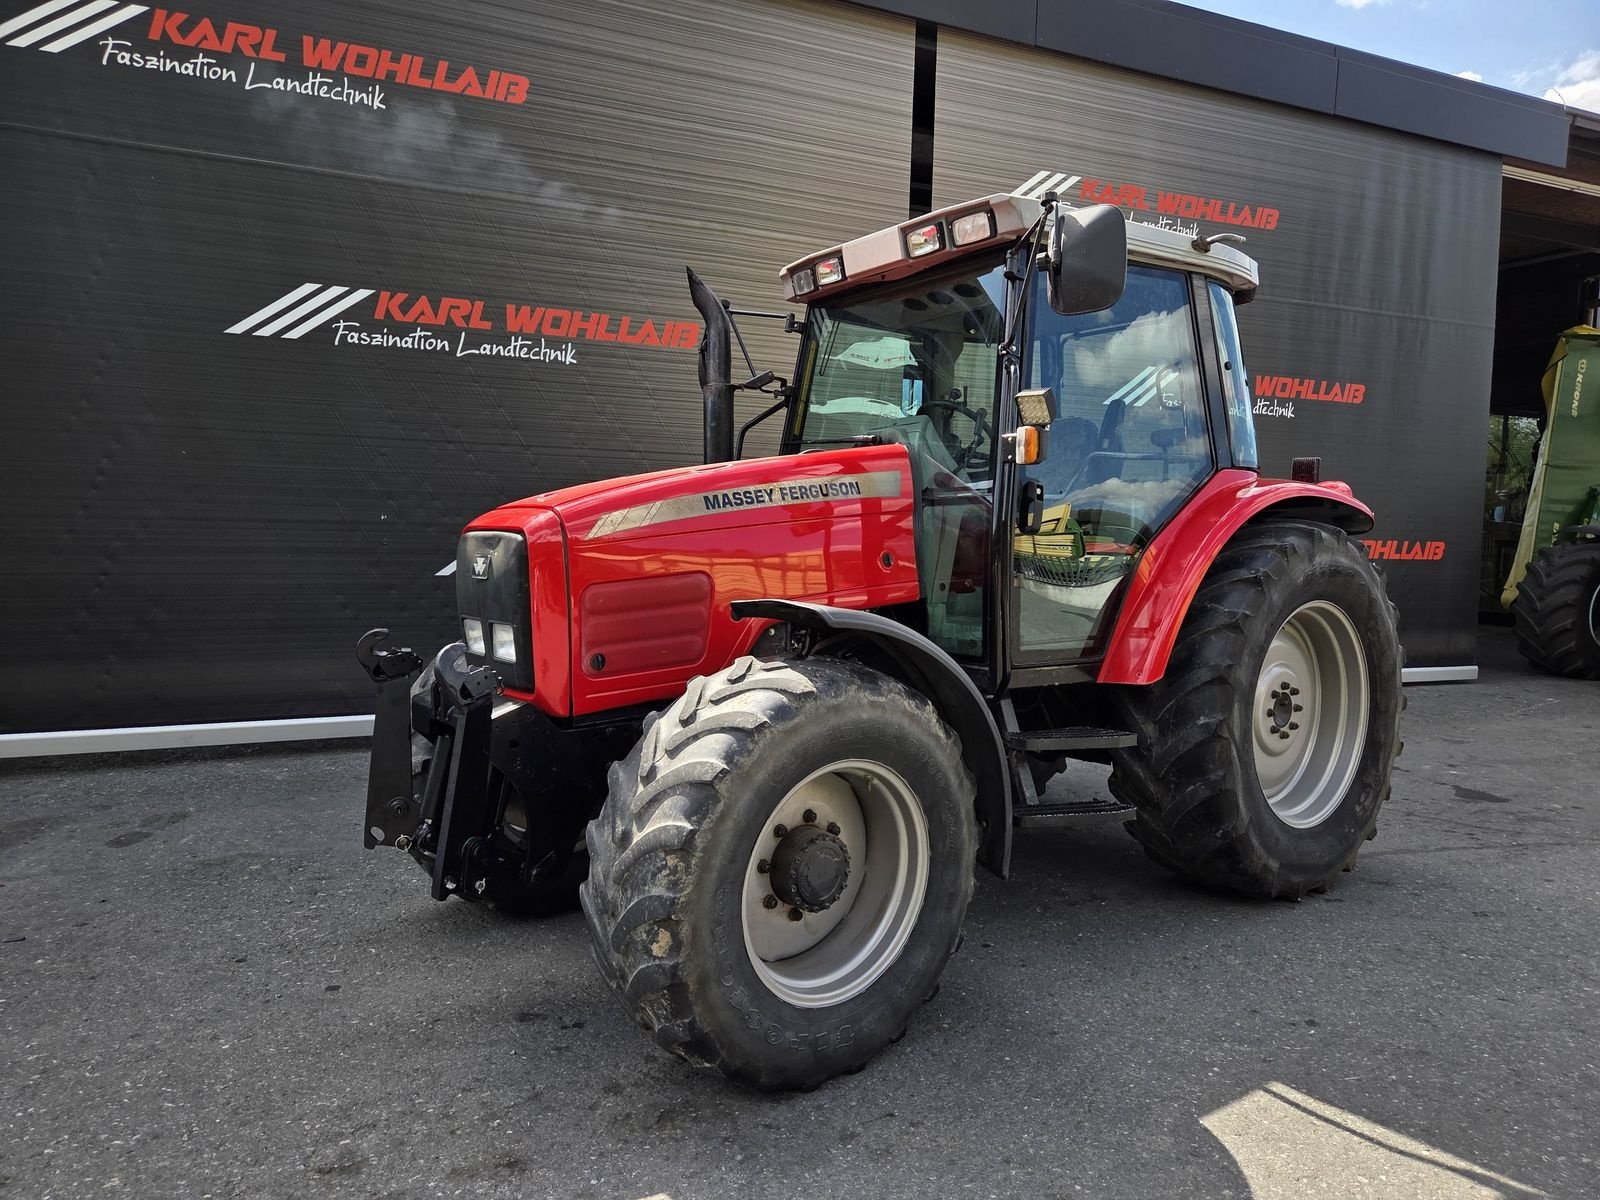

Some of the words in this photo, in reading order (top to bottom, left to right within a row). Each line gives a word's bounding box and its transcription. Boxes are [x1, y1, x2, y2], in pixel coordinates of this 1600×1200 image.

[148, 8, 286, 62] KARL
[100, 37, 237, 83] Faszination
[245, 63, 386, 110] Landtechnik
[1079, 177, 1149, 211] KARL
[374, 291, 492, 330] KARL
[332, 319, 449, 352] Faszination
[456, 332, 578, 365] Landtechnik
[703, 488, 774, 511] MASSEY
[779, 481, 862, 503] FERGUSON
